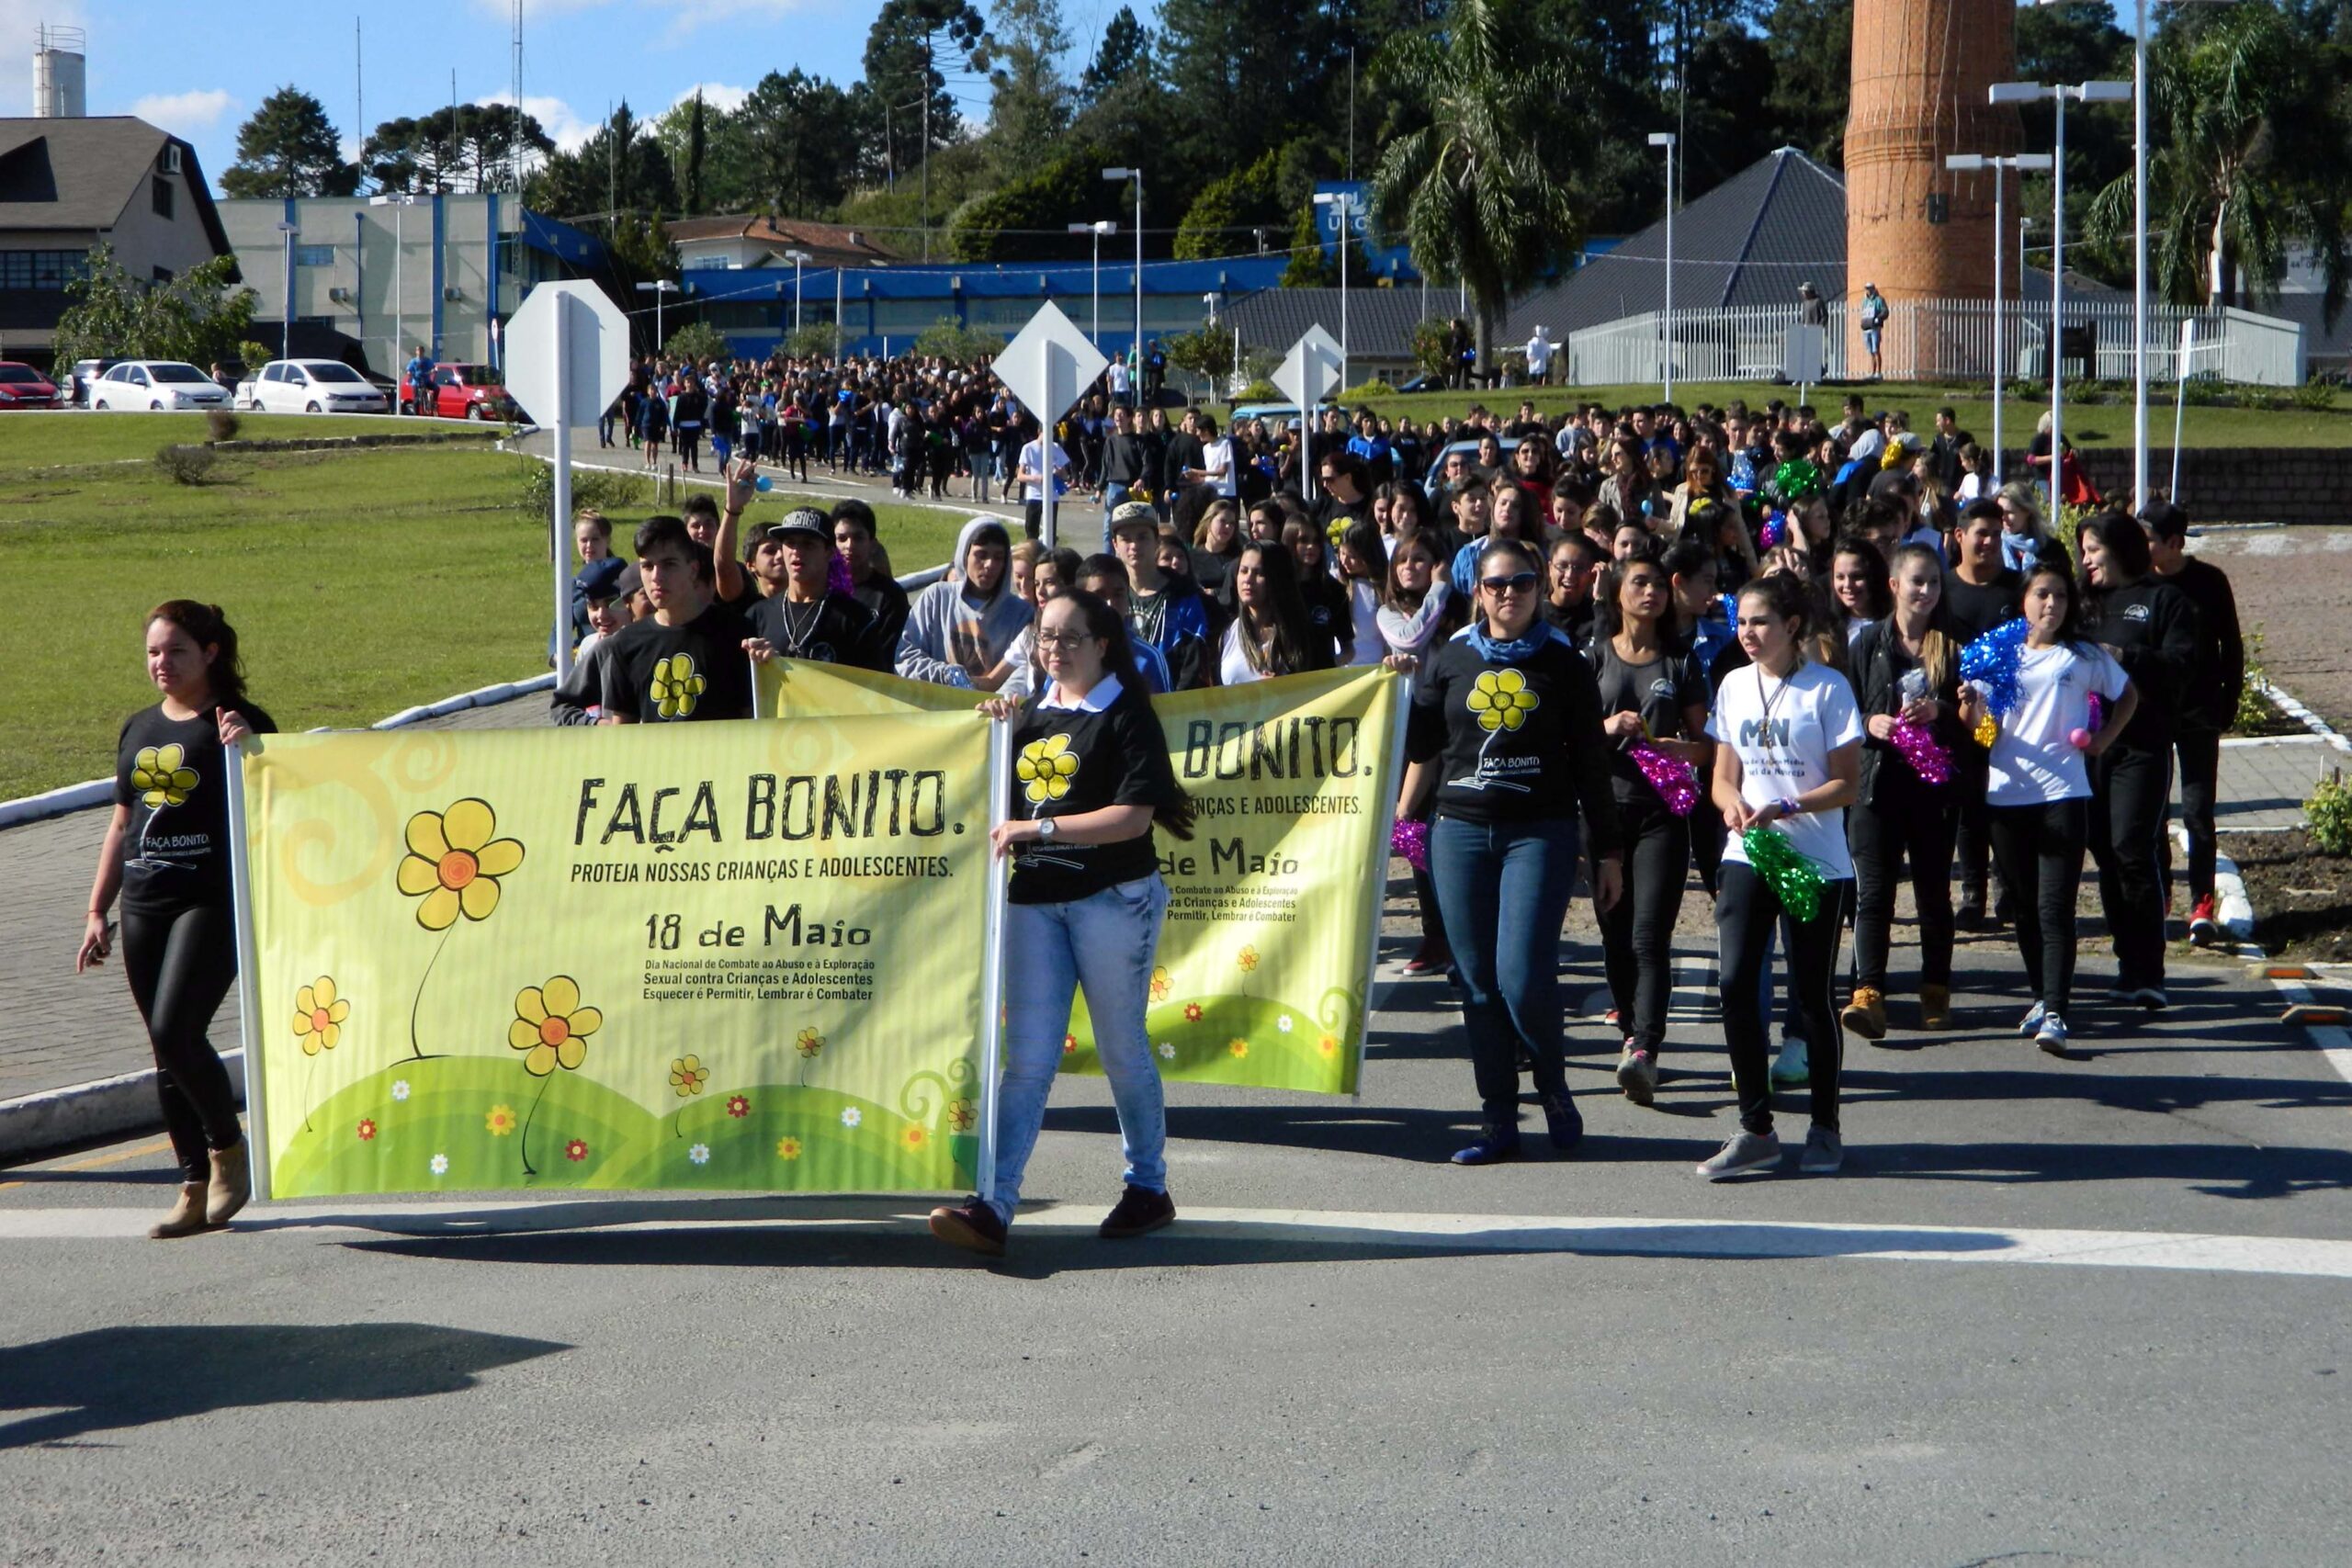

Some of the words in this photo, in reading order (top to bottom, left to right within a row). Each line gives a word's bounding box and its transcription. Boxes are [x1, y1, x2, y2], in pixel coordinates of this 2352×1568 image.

[1183, 716, 1373, 781] BONITO.
[574, 777, 723, 854] FAÇA
[745, 769, 966, 840] BONITO.
[1241, 796, 1250, 815] E
[1255, 795, 1363, 815] ADOLESCENTES.
[146, 837, 171, 850] FAÇA
[1210, 837, 1298, 876] Maio
[571, 863, 639, 884] PROTEJA
[645, 862, 711, 883] NOSSAS
[717, 859, 798, 884] CRIANÇAS
[805, 858, 814, 878] E
[820, 856, 954, 877] ADOLESCENTES.
[1175, 886, 1212, 895] Combate
[1226, 886, 1250, 895] Abuso
[1262, 886, 1298, 897] Exploração
[1184, 897, 1229, 910] Crianças
[1231, 900, 1237, 908] e
[1239, 897, 1296, 908] Adolescentes
[1167, 910, 1209, 922] Permitir,
[1212, 910, 1248, 921] Lembrar
[1250, 910, 1254, 921] é
[1255, 910, 1296, 922] Combater
[646, 913, 681, 951] 18
[698, 920, 745, 948] de
[763, 904, 871, 948] Maio
[645, 959, 661, 969] Dia
[662, 959, 703, 969] Nacional
[705, 959, 717, 969] de
[718, 958, 761, 969] Combate
[763, 961, 775, 969] ao
[775, 959, 805, 969] Abuso
[807, 961, 813, 969] e
[815, 958, 821, 969] à
[823, 958, 876, 972] Exploração
[644, 972, 682, 985] Sexual
[685, 973, 723, 985] contra
[727, 972, 780, 987] Crianças
[782, 975, 789, 985] e
[792, 972, 874, 986] Adolescentes
[643, 987, 695, 1001] Esquecer
[696, 987, 704, 999] é
[706, 987, 754, 1001] Permitir,
[757, 987, 805, 999] Lembrar
[807, 987, 814, 999] é
[817, 987, 874, 1000] Combater
